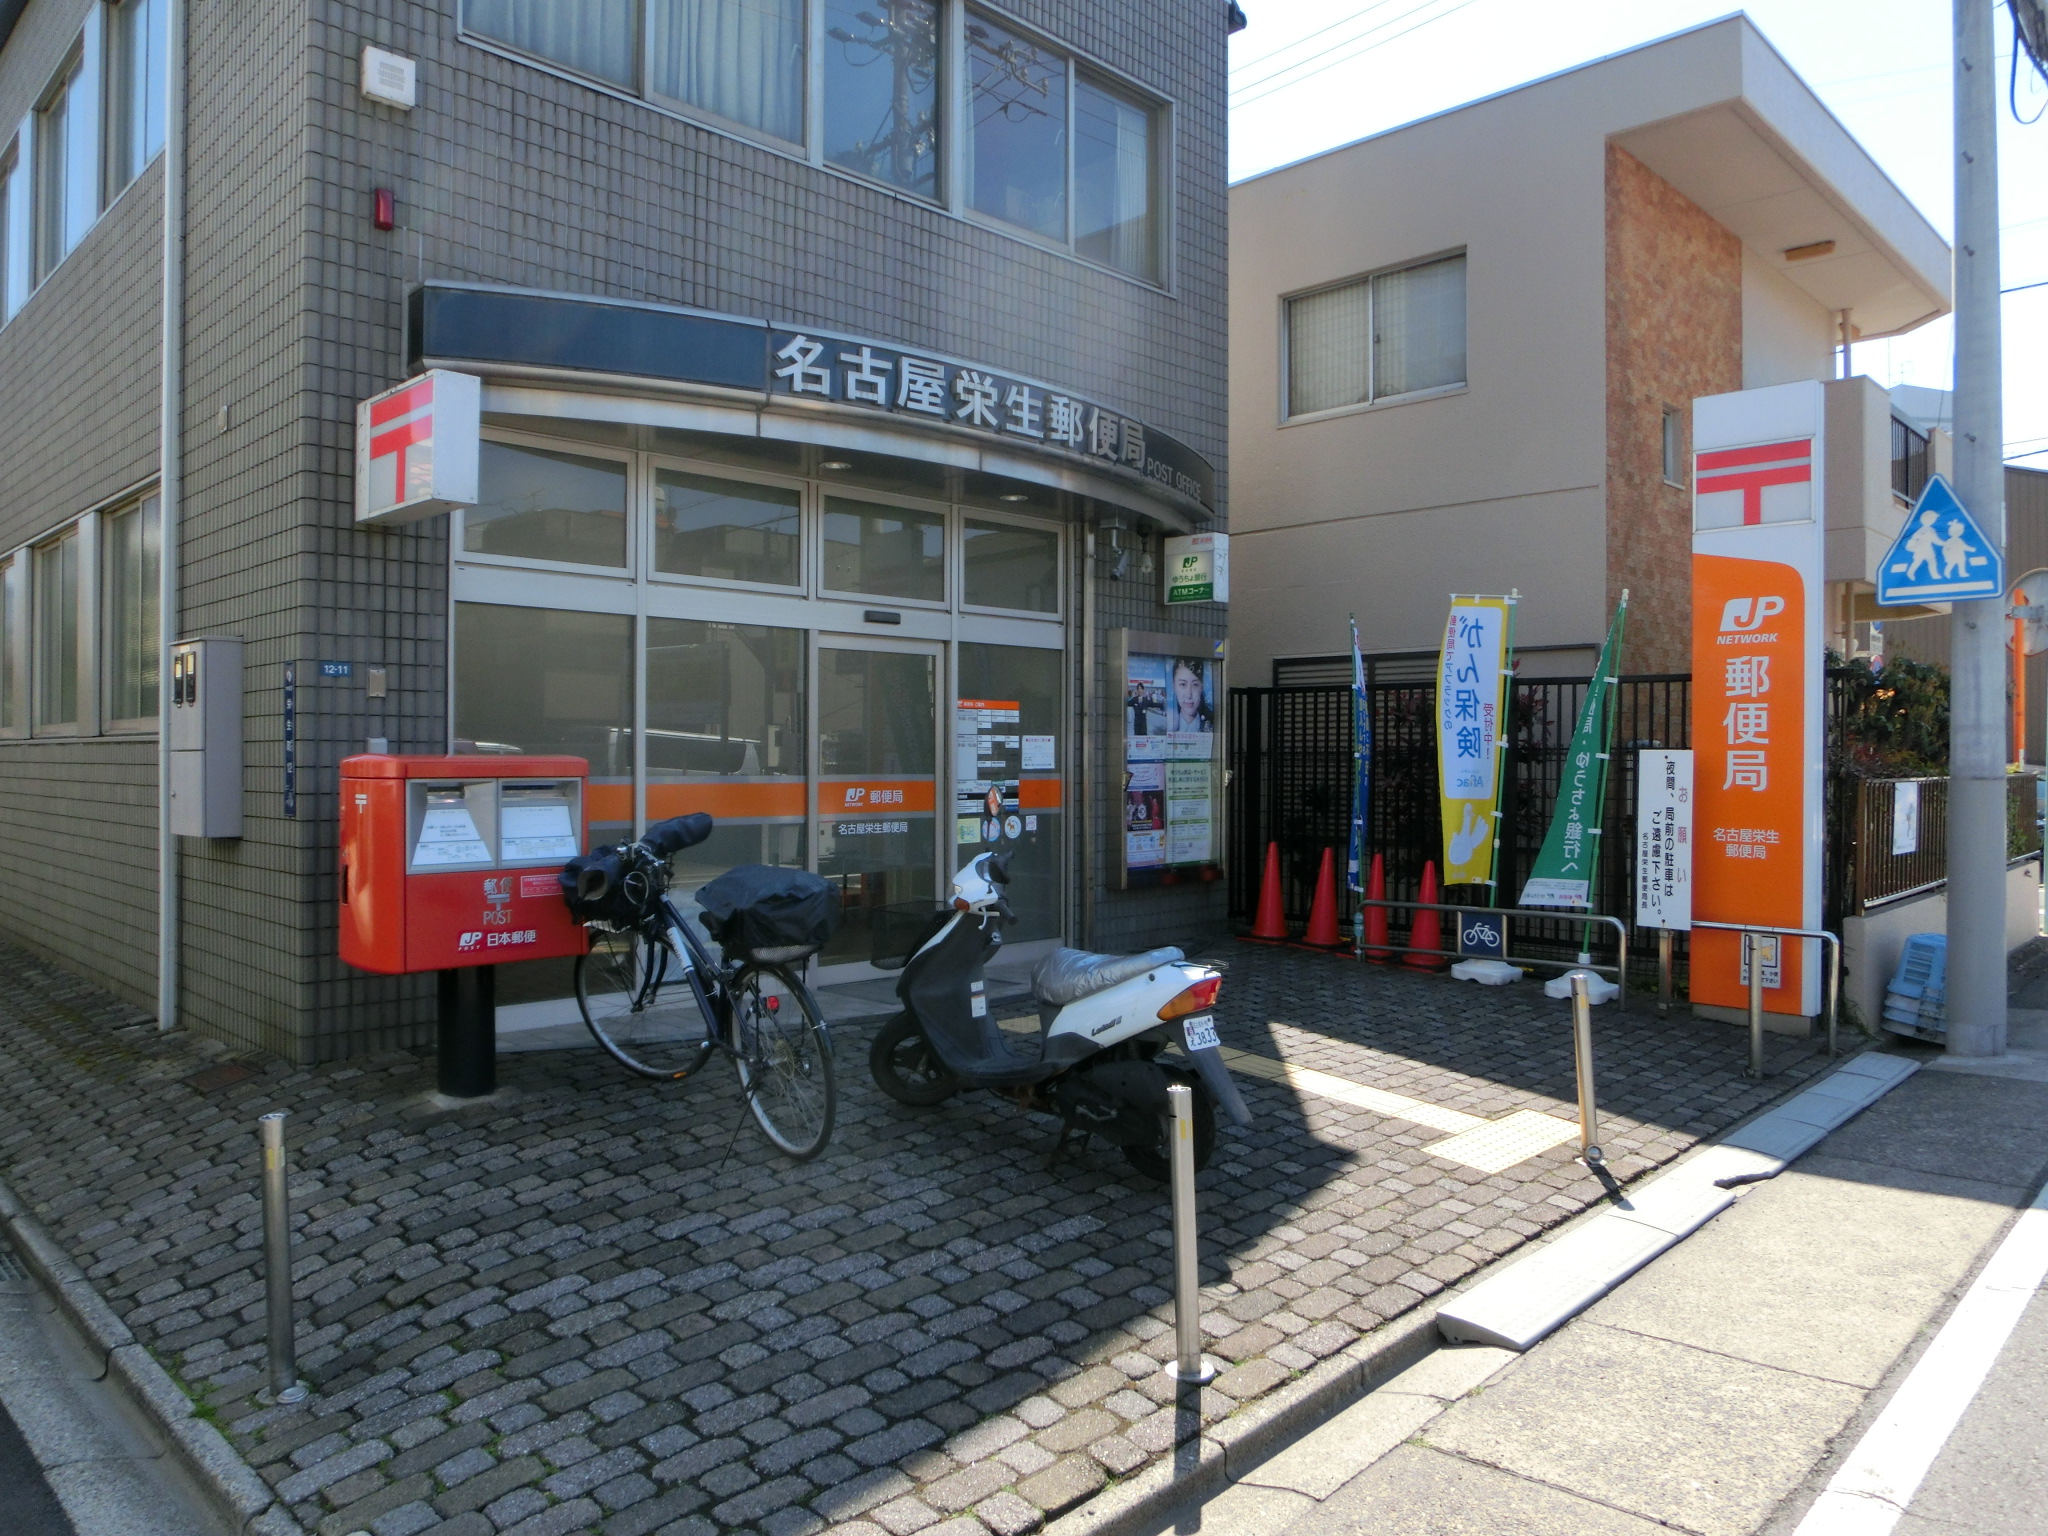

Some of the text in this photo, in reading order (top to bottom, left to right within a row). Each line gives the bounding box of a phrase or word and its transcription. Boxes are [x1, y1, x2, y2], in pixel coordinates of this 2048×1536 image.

[773, 334, 1146, 468] 名古屋栄生郵便局
[1147, 458, 1202, 500] POST OFFICE
[1172, 573, 1207, 583] ゆうちょ銀行
[1173, 585, 1210, 596] ATMコーナー
[1716, 632, 1778, 645] NETWORK
[324, 665, 348, 675] 12-11
[1722, 655, 1770, 792] 郵便局
[870, 789, 903, 804] 郵便局
[838, 821, 908, 835] 名古屋栄生郵便局
[1664, 761, 1676, 897] 夜間、局前の駐車は
[1676, 786, 1689, 884] お願い
[1713, 827, 1780, 844] 名古屋栄生
[1725, 844, 1766, 859] 郵便局
[1651, 810, 1662, 915] ご遠慮下さい。
[484, 877, 512, 895] 郵便
[483, 909, 512, 925] POST
[487, 930, 536, 947] 日本郵便
[1197, 1028, 1217, 1045] 3833
